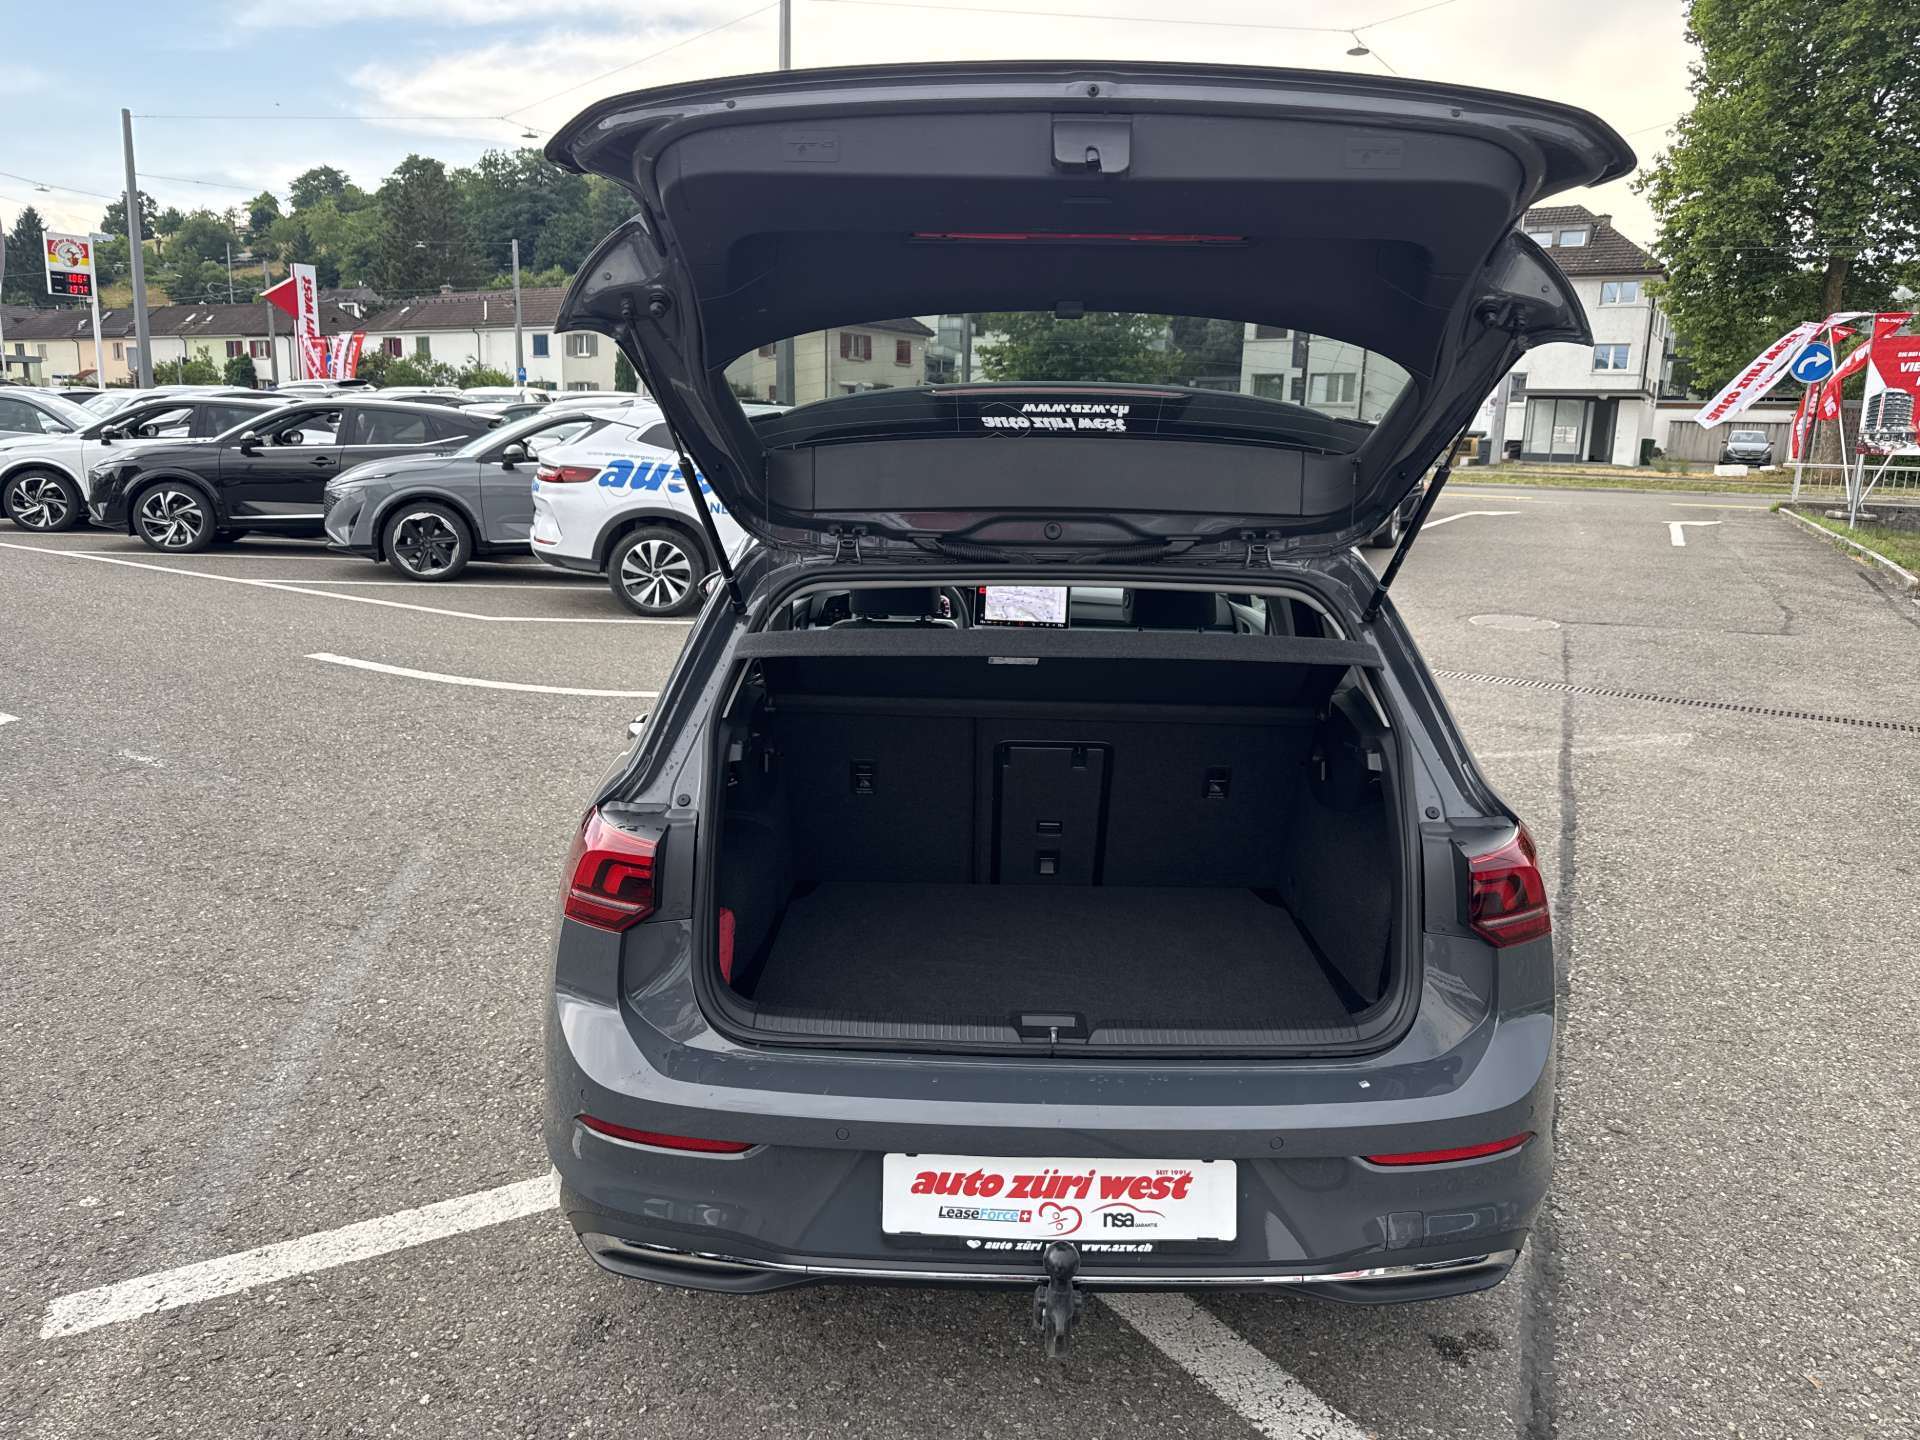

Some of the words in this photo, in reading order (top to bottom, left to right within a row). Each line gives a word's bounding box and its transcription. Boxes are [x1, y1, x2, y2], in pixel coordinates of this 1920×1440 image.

[911, 1168, 1004, 1198] auto
[1005, 1169, 1095, 1199] züri
[1100, 1170, 1194, 1200] west
[938, 1205, 1018, 1221] LeaseForce
[1103, 1212, 1134, 1228] nsa
[984, 1240, 1012, 1250] auto
[1015, 1240, 1043, 1251] züri
[1081, 1242, 1153, 1253] www.azw.ch
